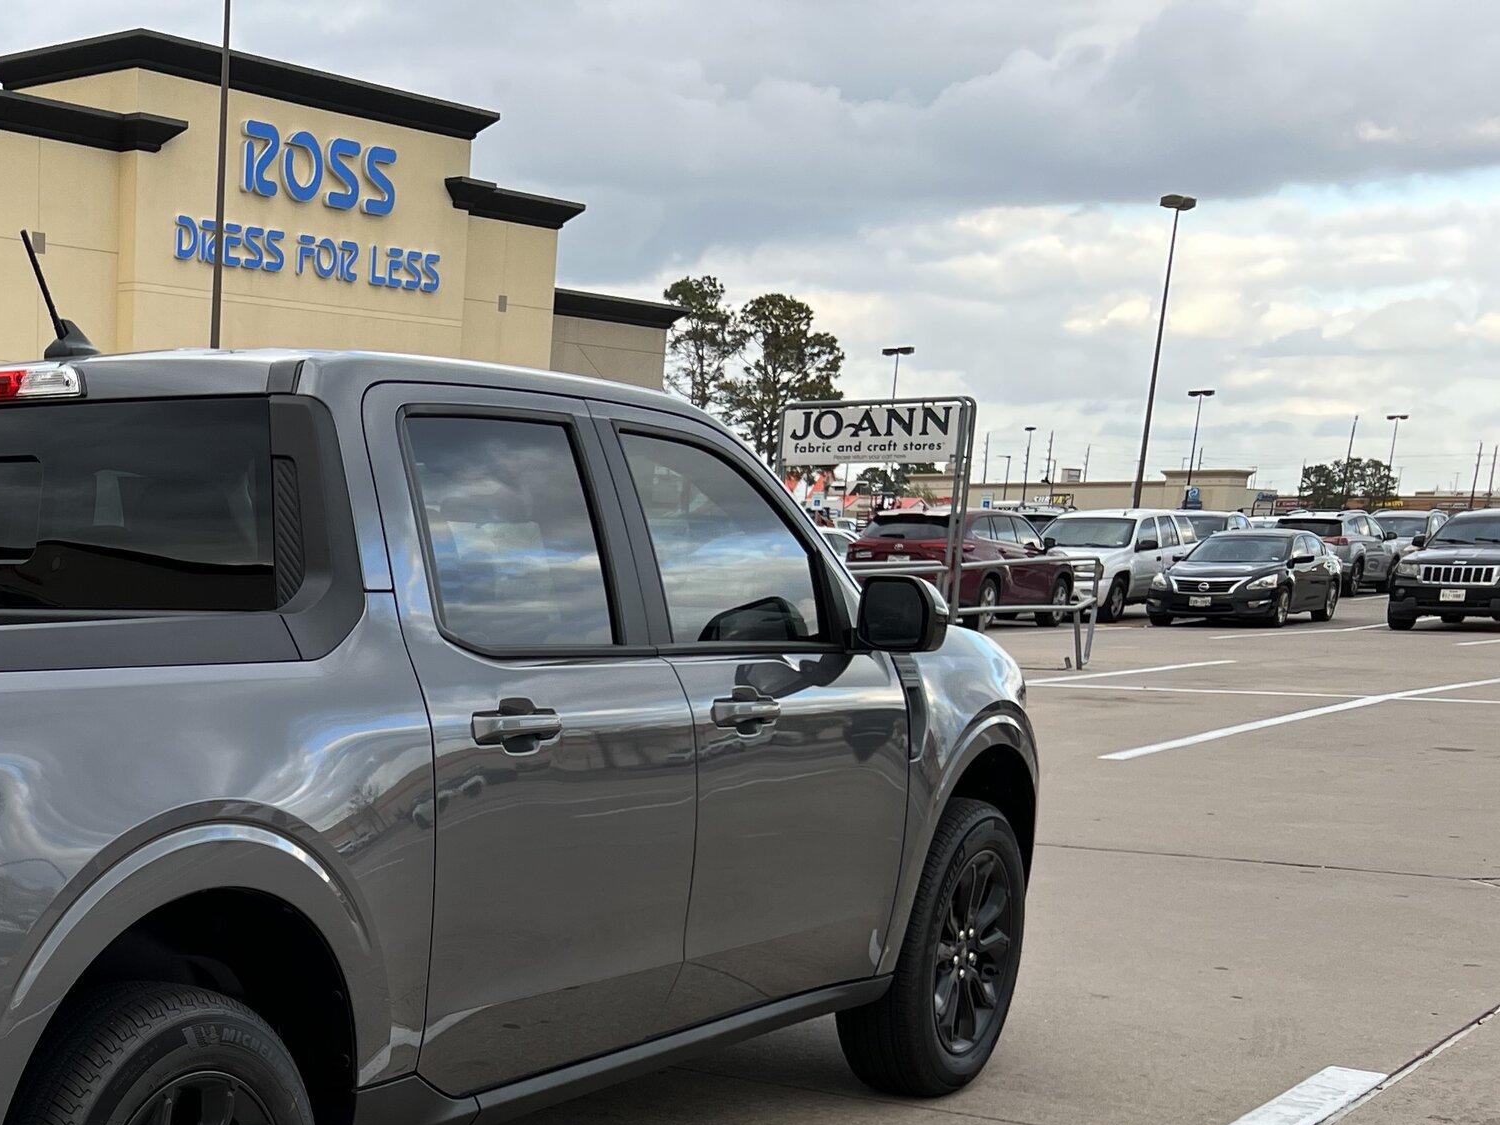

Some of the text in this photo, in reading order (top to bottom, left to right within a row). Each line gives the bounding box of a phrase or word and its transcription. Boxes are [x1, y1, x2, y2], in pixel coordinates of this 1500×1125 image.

[240, 119, 397, 217] ROSS
[175, 214, 441, 293] DRESS FOR LESS
[794, 440, 943, 454] fabric and craft stores
